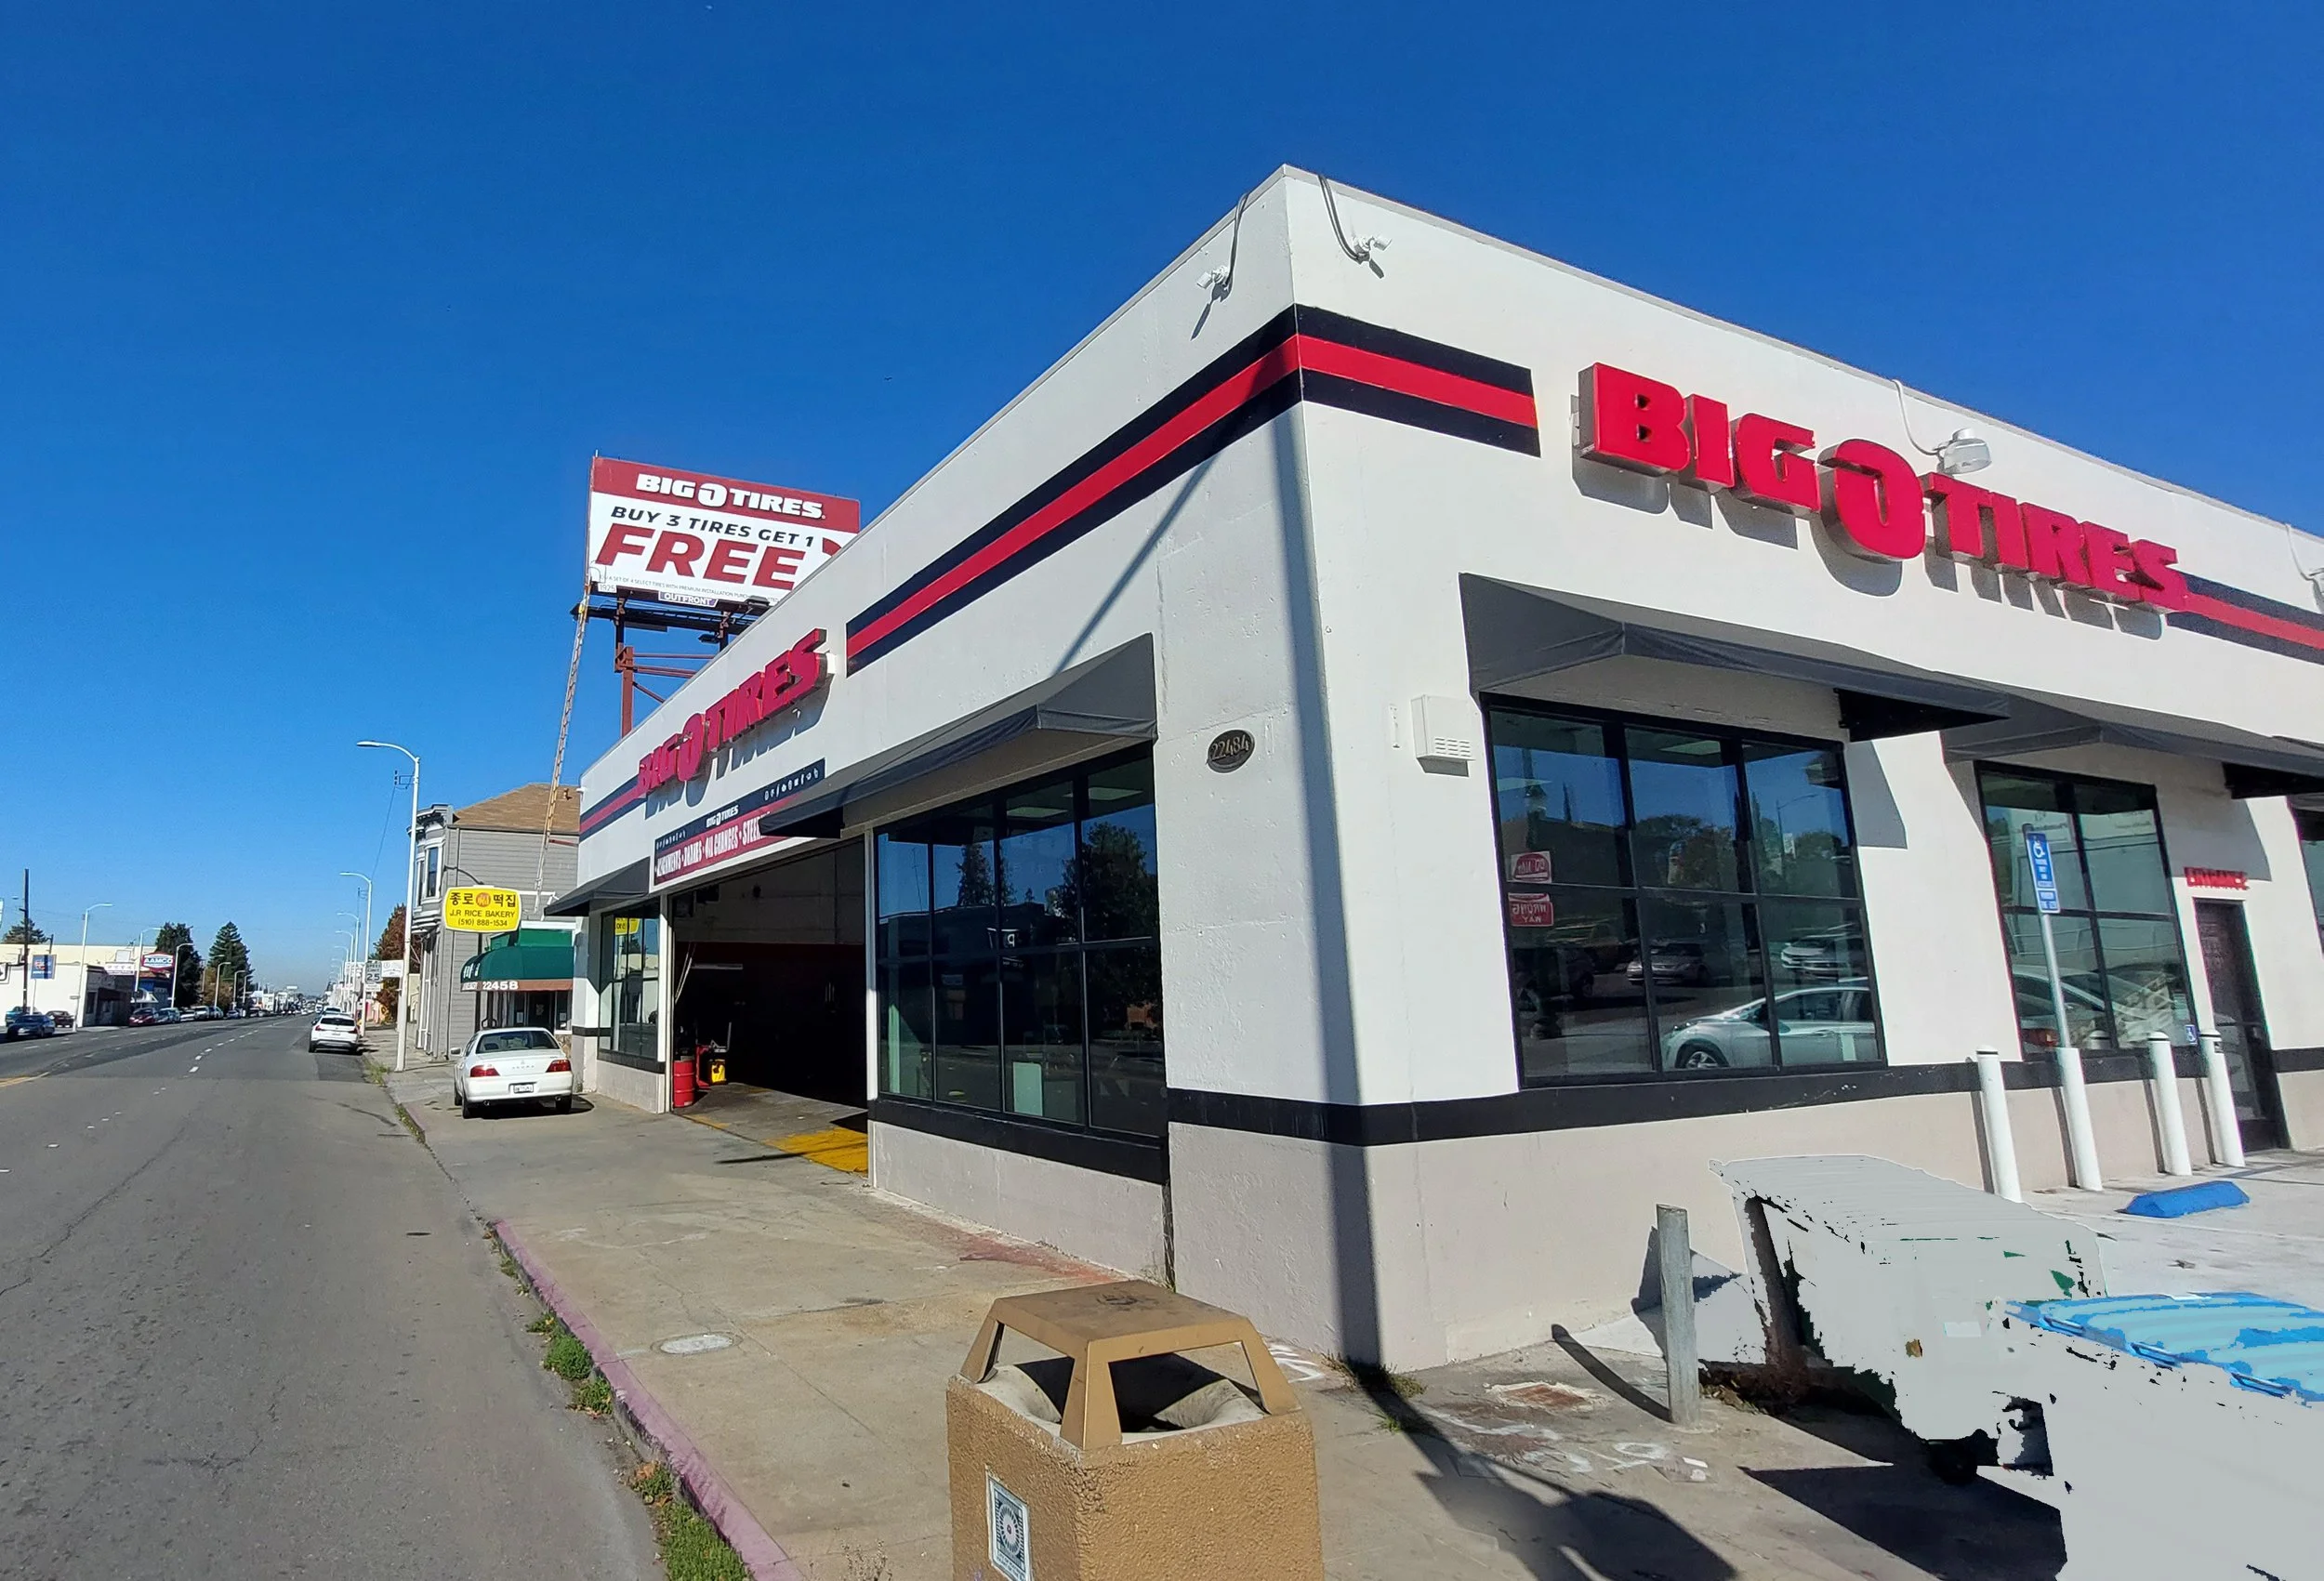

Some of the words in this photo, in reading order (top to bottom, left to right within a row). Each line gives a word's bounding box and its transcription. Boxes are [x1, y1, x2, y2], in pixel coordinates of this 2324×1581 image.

[636, 473, 695, 498] BIG
[698, 483, 727, 507] O
[730, 488, 823, 520] TIRES
[1582, 362, 1821, 519] BIG
[1819, 439, 1924, 562] O
[1923, 471, 2190, 615] TIRES
[611, 506, 662, 523] BUY
[667, 515, 680, 527] 3
[689, 518, 752, 537] TIRES
[758, 528, 799, 545] GET
[806, 536, 814, 547] 1
[595, 523, 806, 590] FREE
[664, 593, 712, 607] OUTFRONT
[638, 732, 682, 791] BIG
[706, 628, 827, 753] TIRES
[1211, 734, 1249, 759] 22484
[450, 892, 474, 906] 종로
[494, 894, 516, 907] 떡집
[482, 981, 519, 990] 22458
